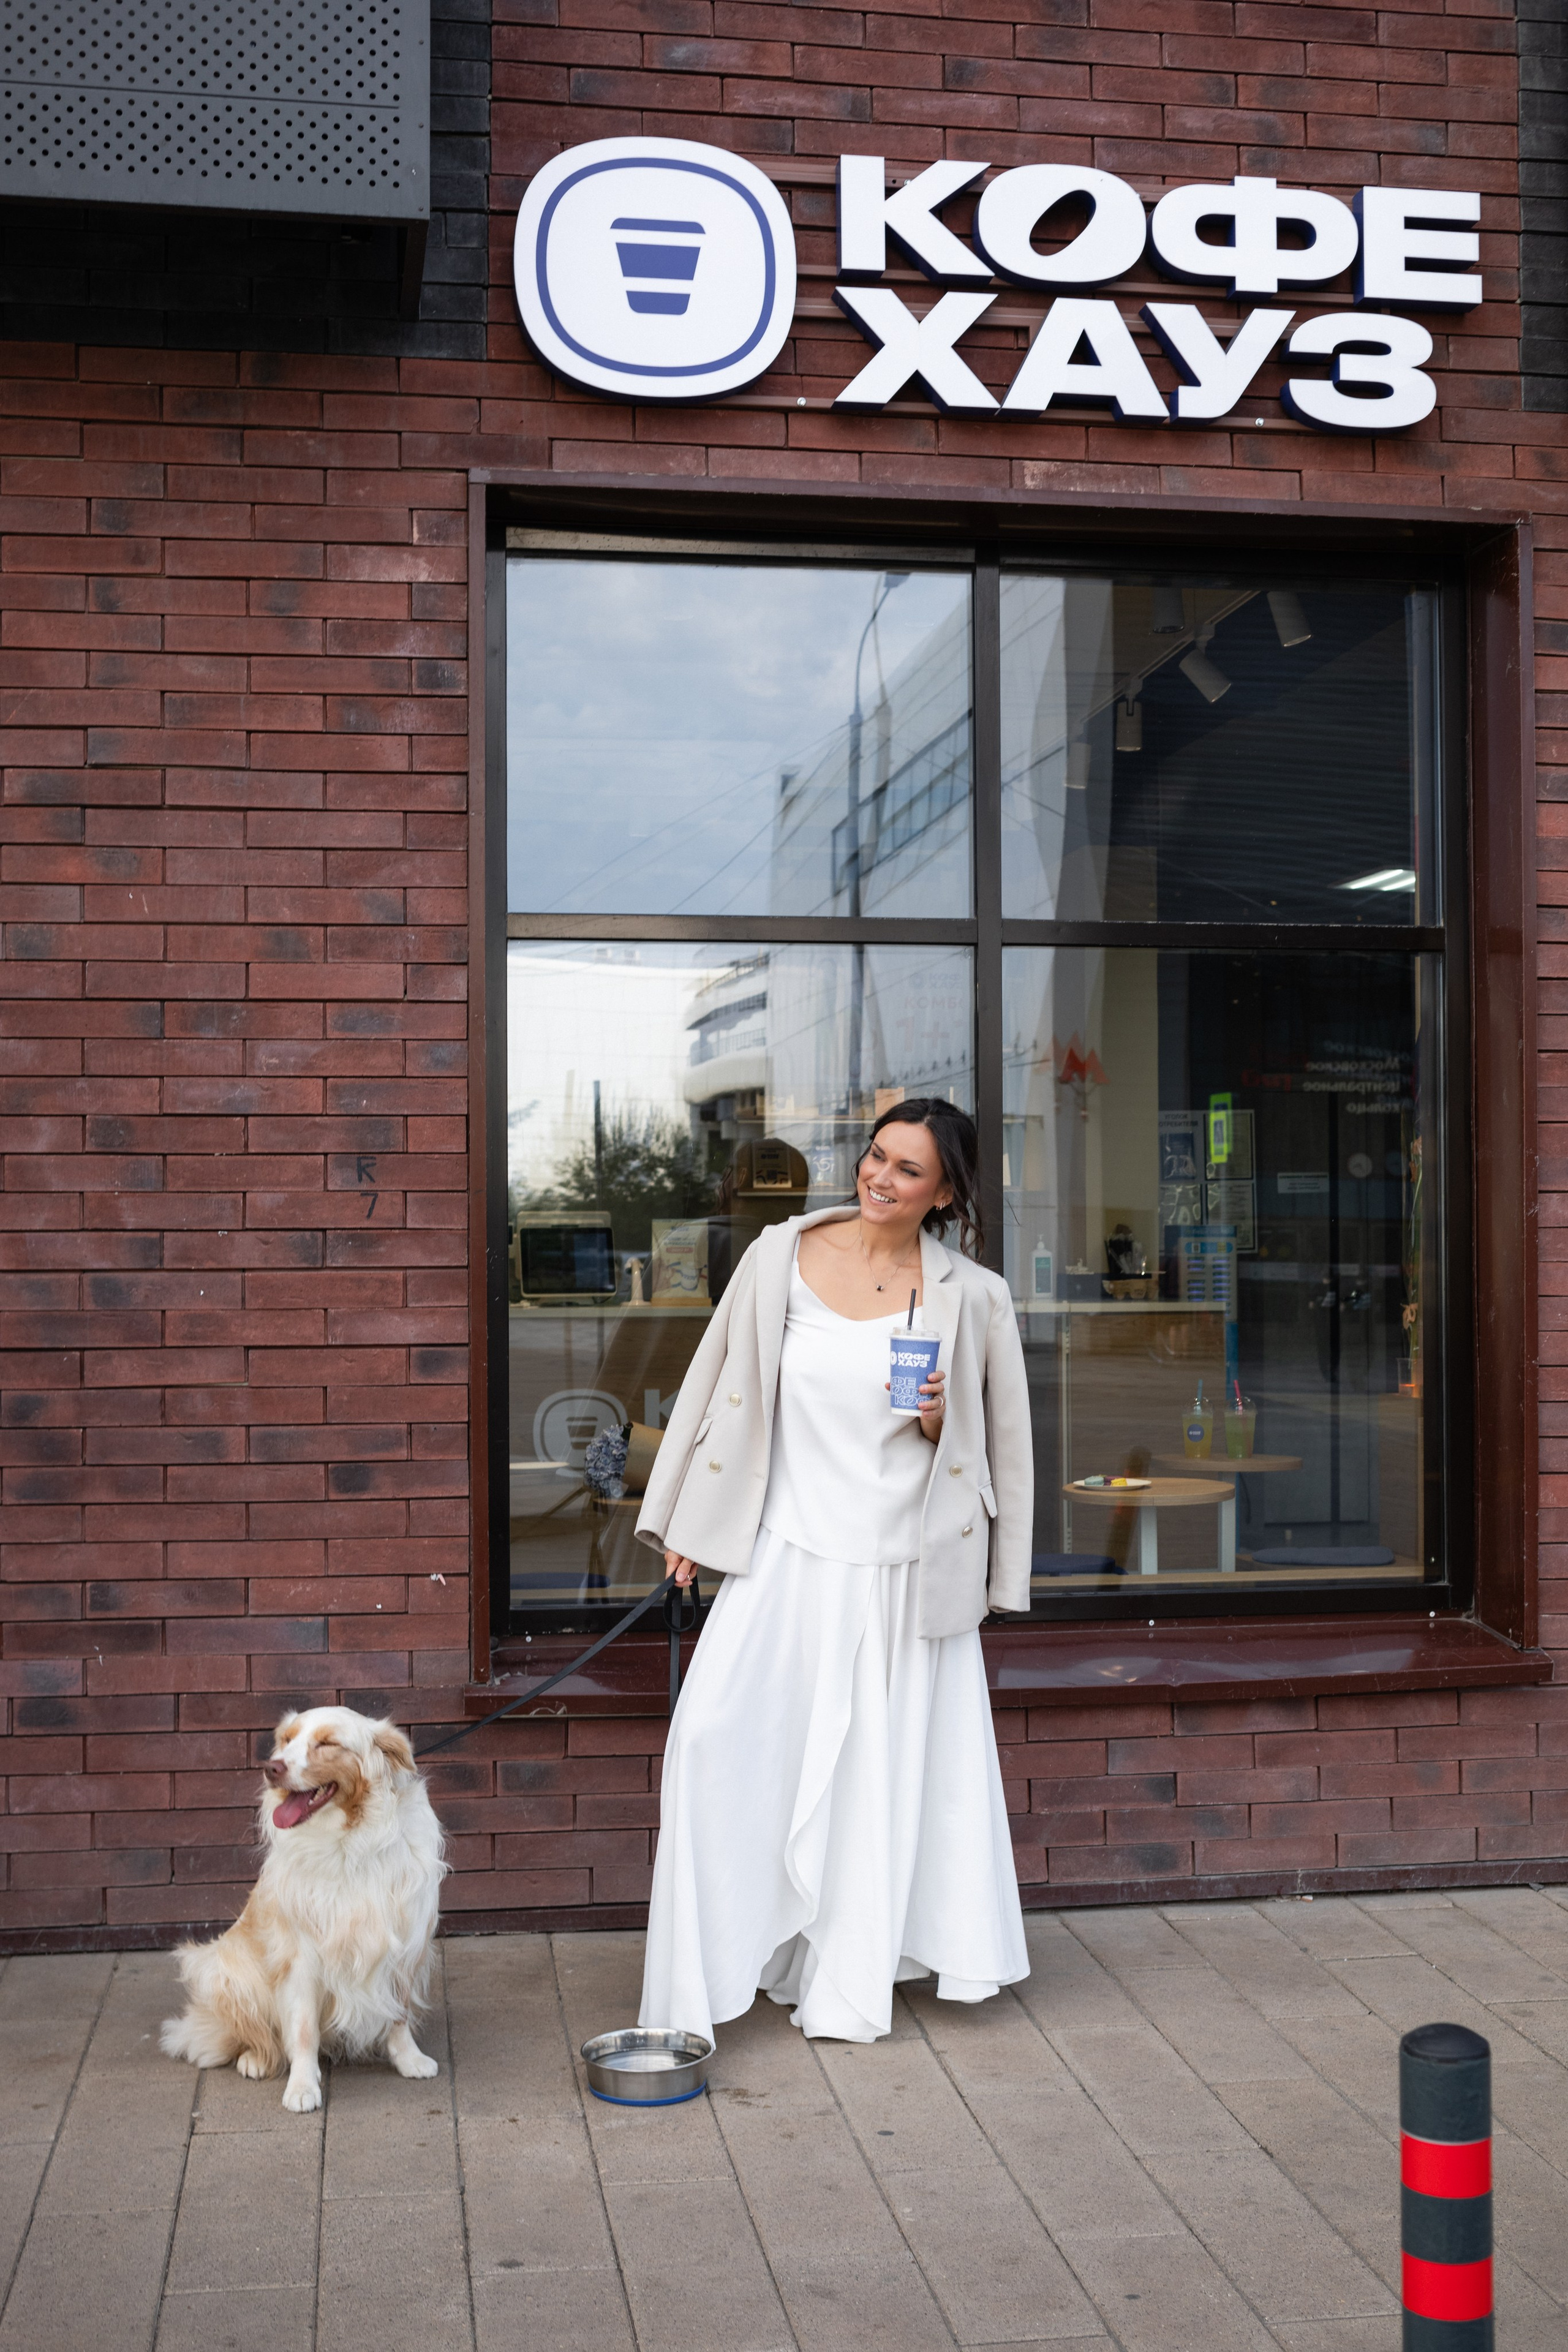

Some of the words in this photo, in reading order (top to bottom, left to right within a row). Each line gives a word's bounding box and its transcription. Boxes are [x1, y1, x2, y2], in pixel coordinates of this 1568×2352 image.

[837, 154, 1482, 310] КОФЕ
[831, 285, 1437, 432] ХАУЗ
[360, 1193, 379, 1219] 7
[898, 1352, 930, 1361] КОФЕ
[898, 1359, 928, 1368] ХАУЗ
